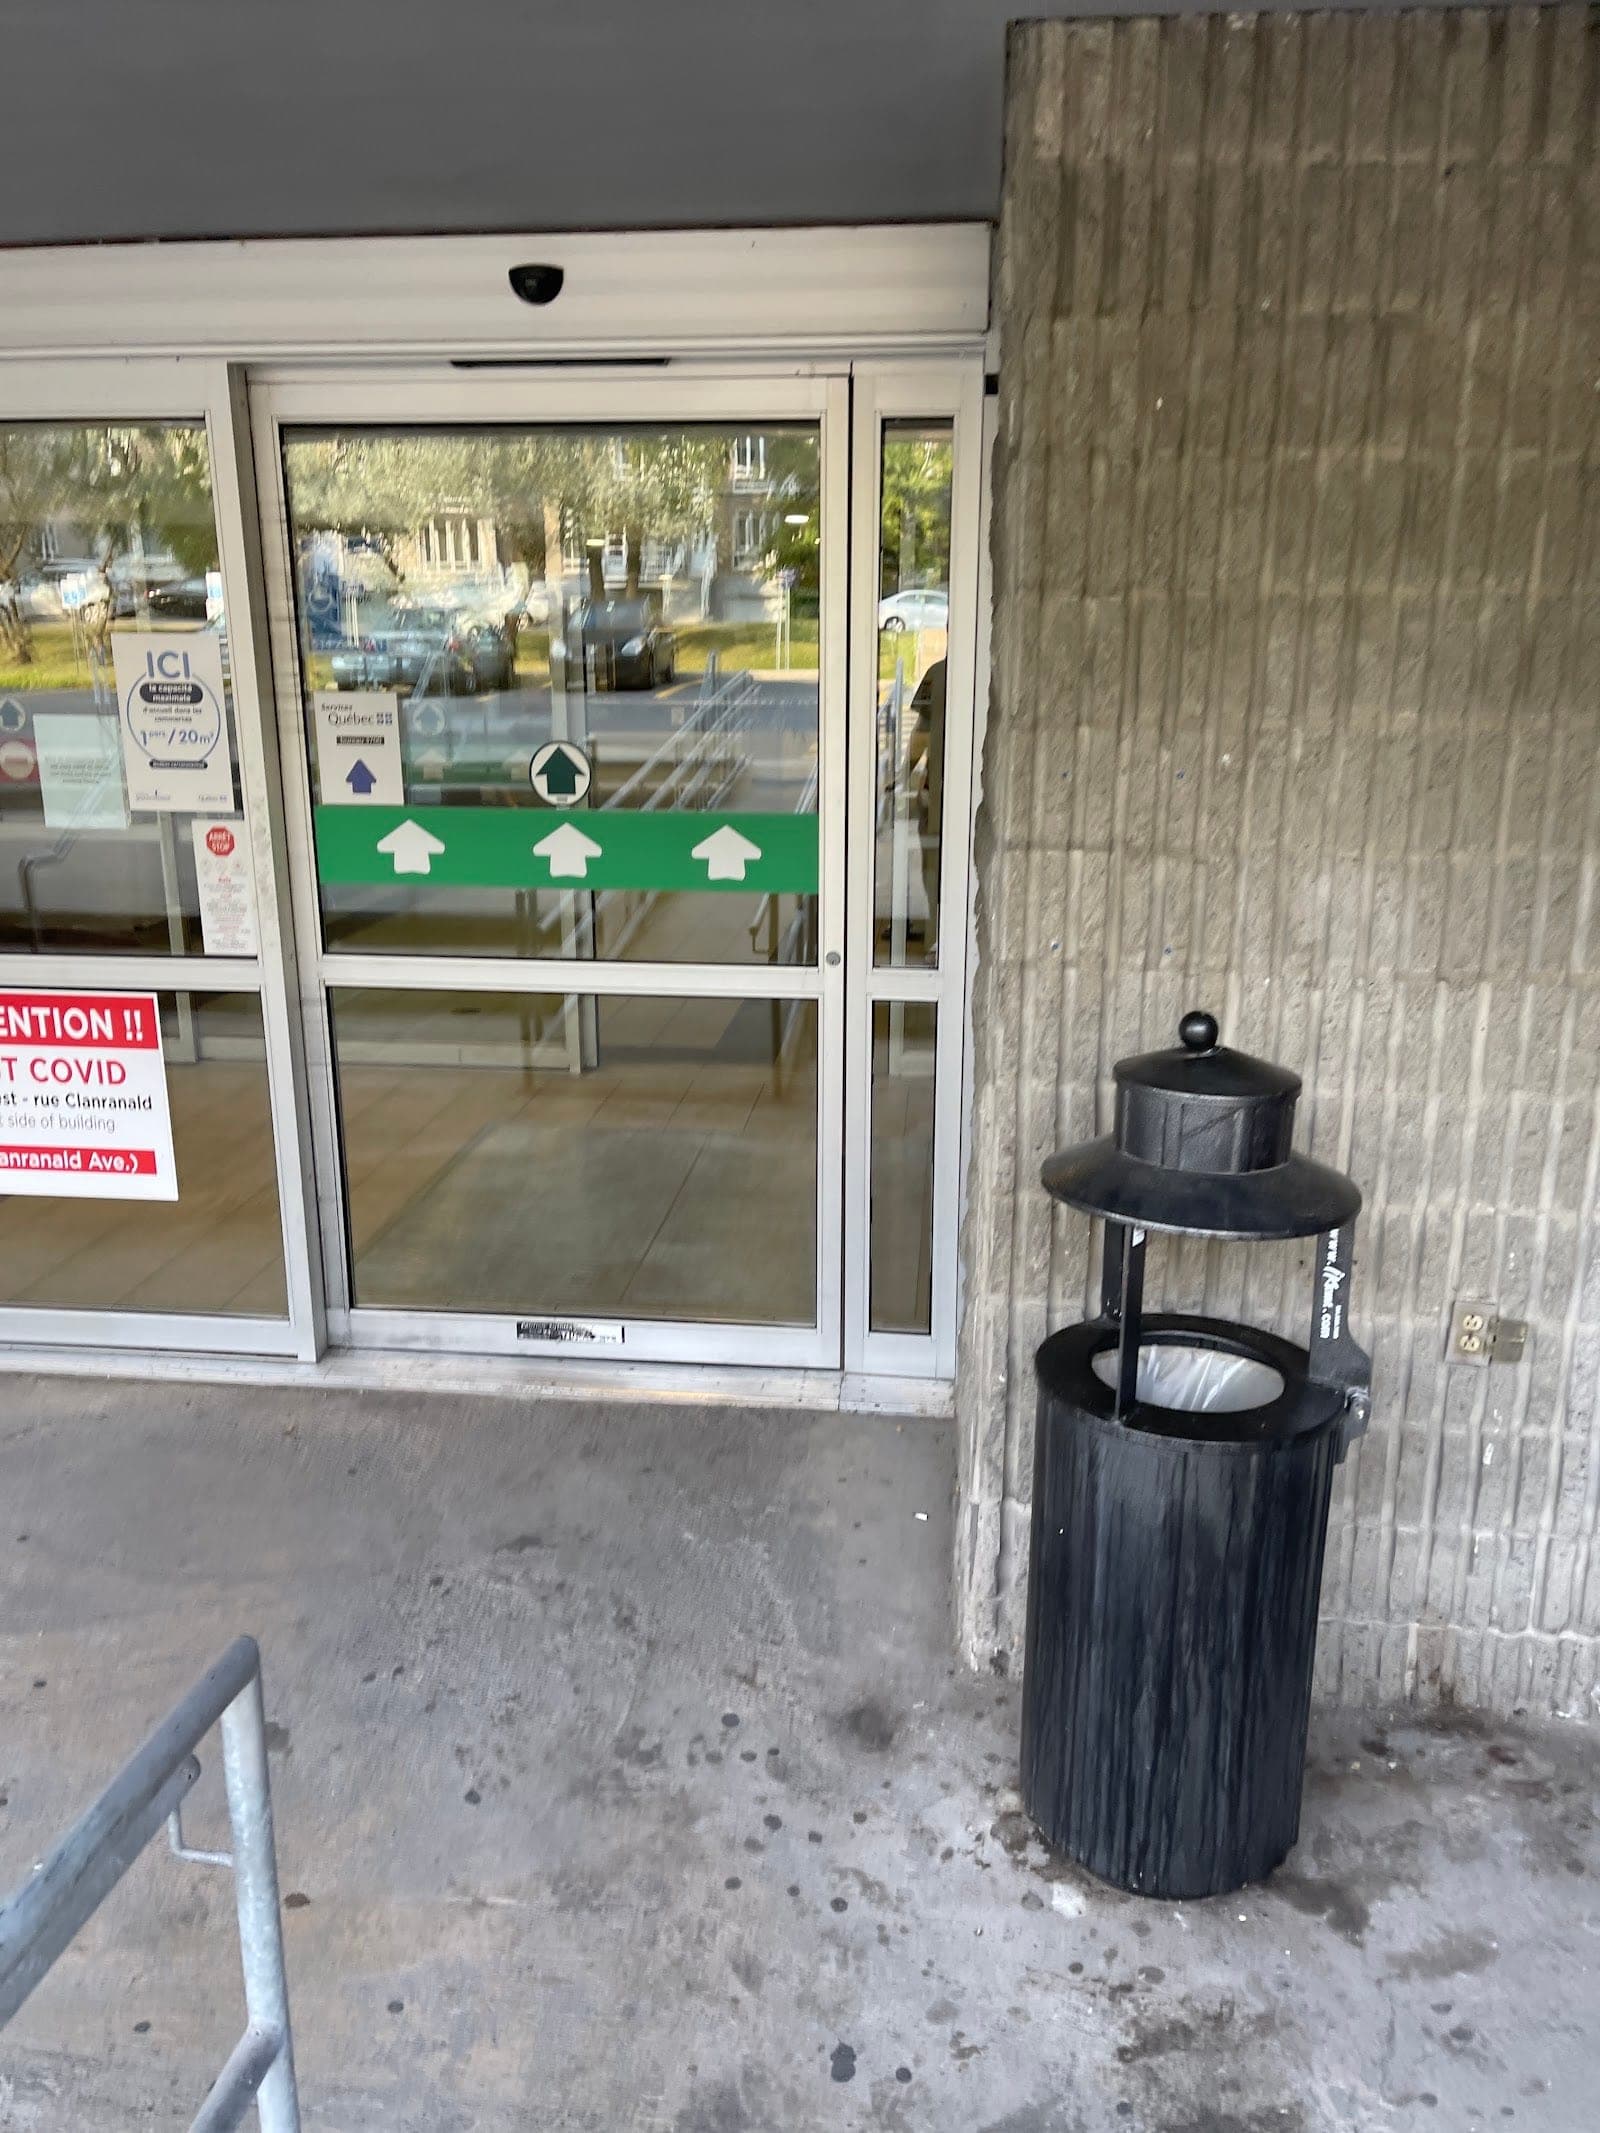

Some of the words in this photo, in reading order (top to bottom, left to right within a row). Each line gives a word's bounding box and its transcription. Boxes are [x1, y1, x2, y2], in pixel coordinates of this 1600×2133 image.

[146, 650, 190, 679] ICI
[321, 703, 353, 712] Services
[328, 711, 374, 727] Québec
[30, 1057, 126, 1085] COVID
[34, 1094, 59, 1108] rue
[65, 1093, 152, 1110] Clanranald
[8, 1112, 36, 1128] side
[40, 1112, 54, 1129] of
[58, 1113, 116, 1133] building
